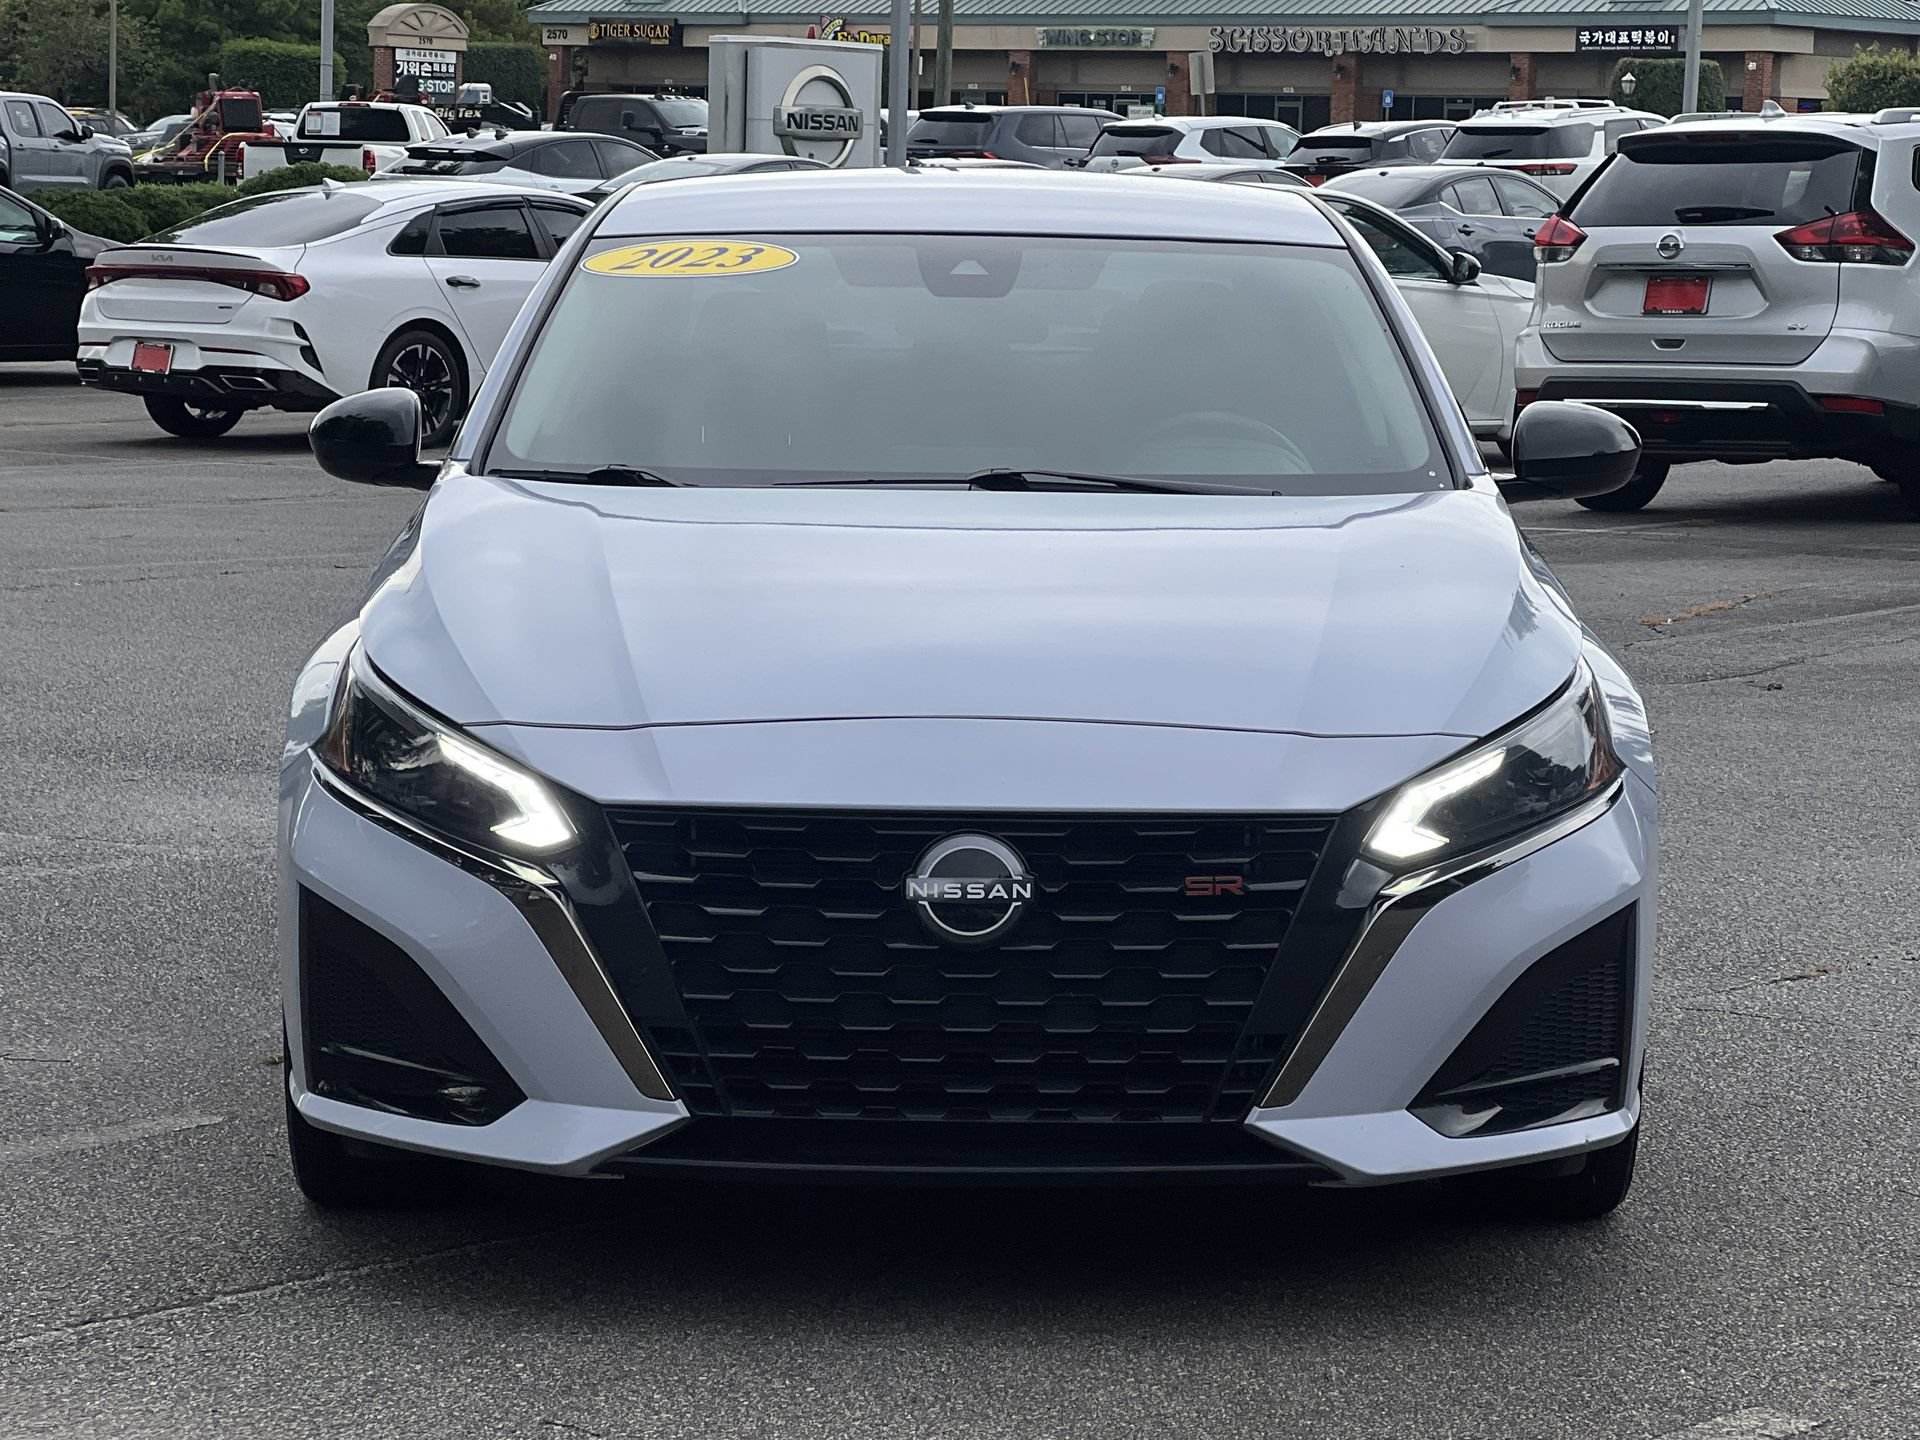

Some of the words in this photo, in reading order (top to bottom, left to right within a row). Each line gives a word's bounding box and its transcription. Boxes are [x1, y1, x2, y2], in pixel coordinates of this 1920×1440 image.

[546, 29, 568, 40] 2570
[600, 23, 630, 38] TIGER
[633, 23, 670, 38] SUGAR
[1094, 28, 1143, 47] STOP
[1579, 29, 1669, 44] 국가대표떡볶이
[418, 37, 434, 45] 2570
[1209, 25, 1468, 56] SCISSORHANDS
[396, 61, 432, 77] 가위손
[435, 107, 455, 120] Big
[457, 107, 482, 118] Tex
[786, 112, 859, 132] NISSAN
[609, 246, 765, 271] 2023
[1543, 321, 1582, 329] ROGUE
[908, 881, 1032, 900] NISSAN
[1185, 875, 1245, 896] SR
